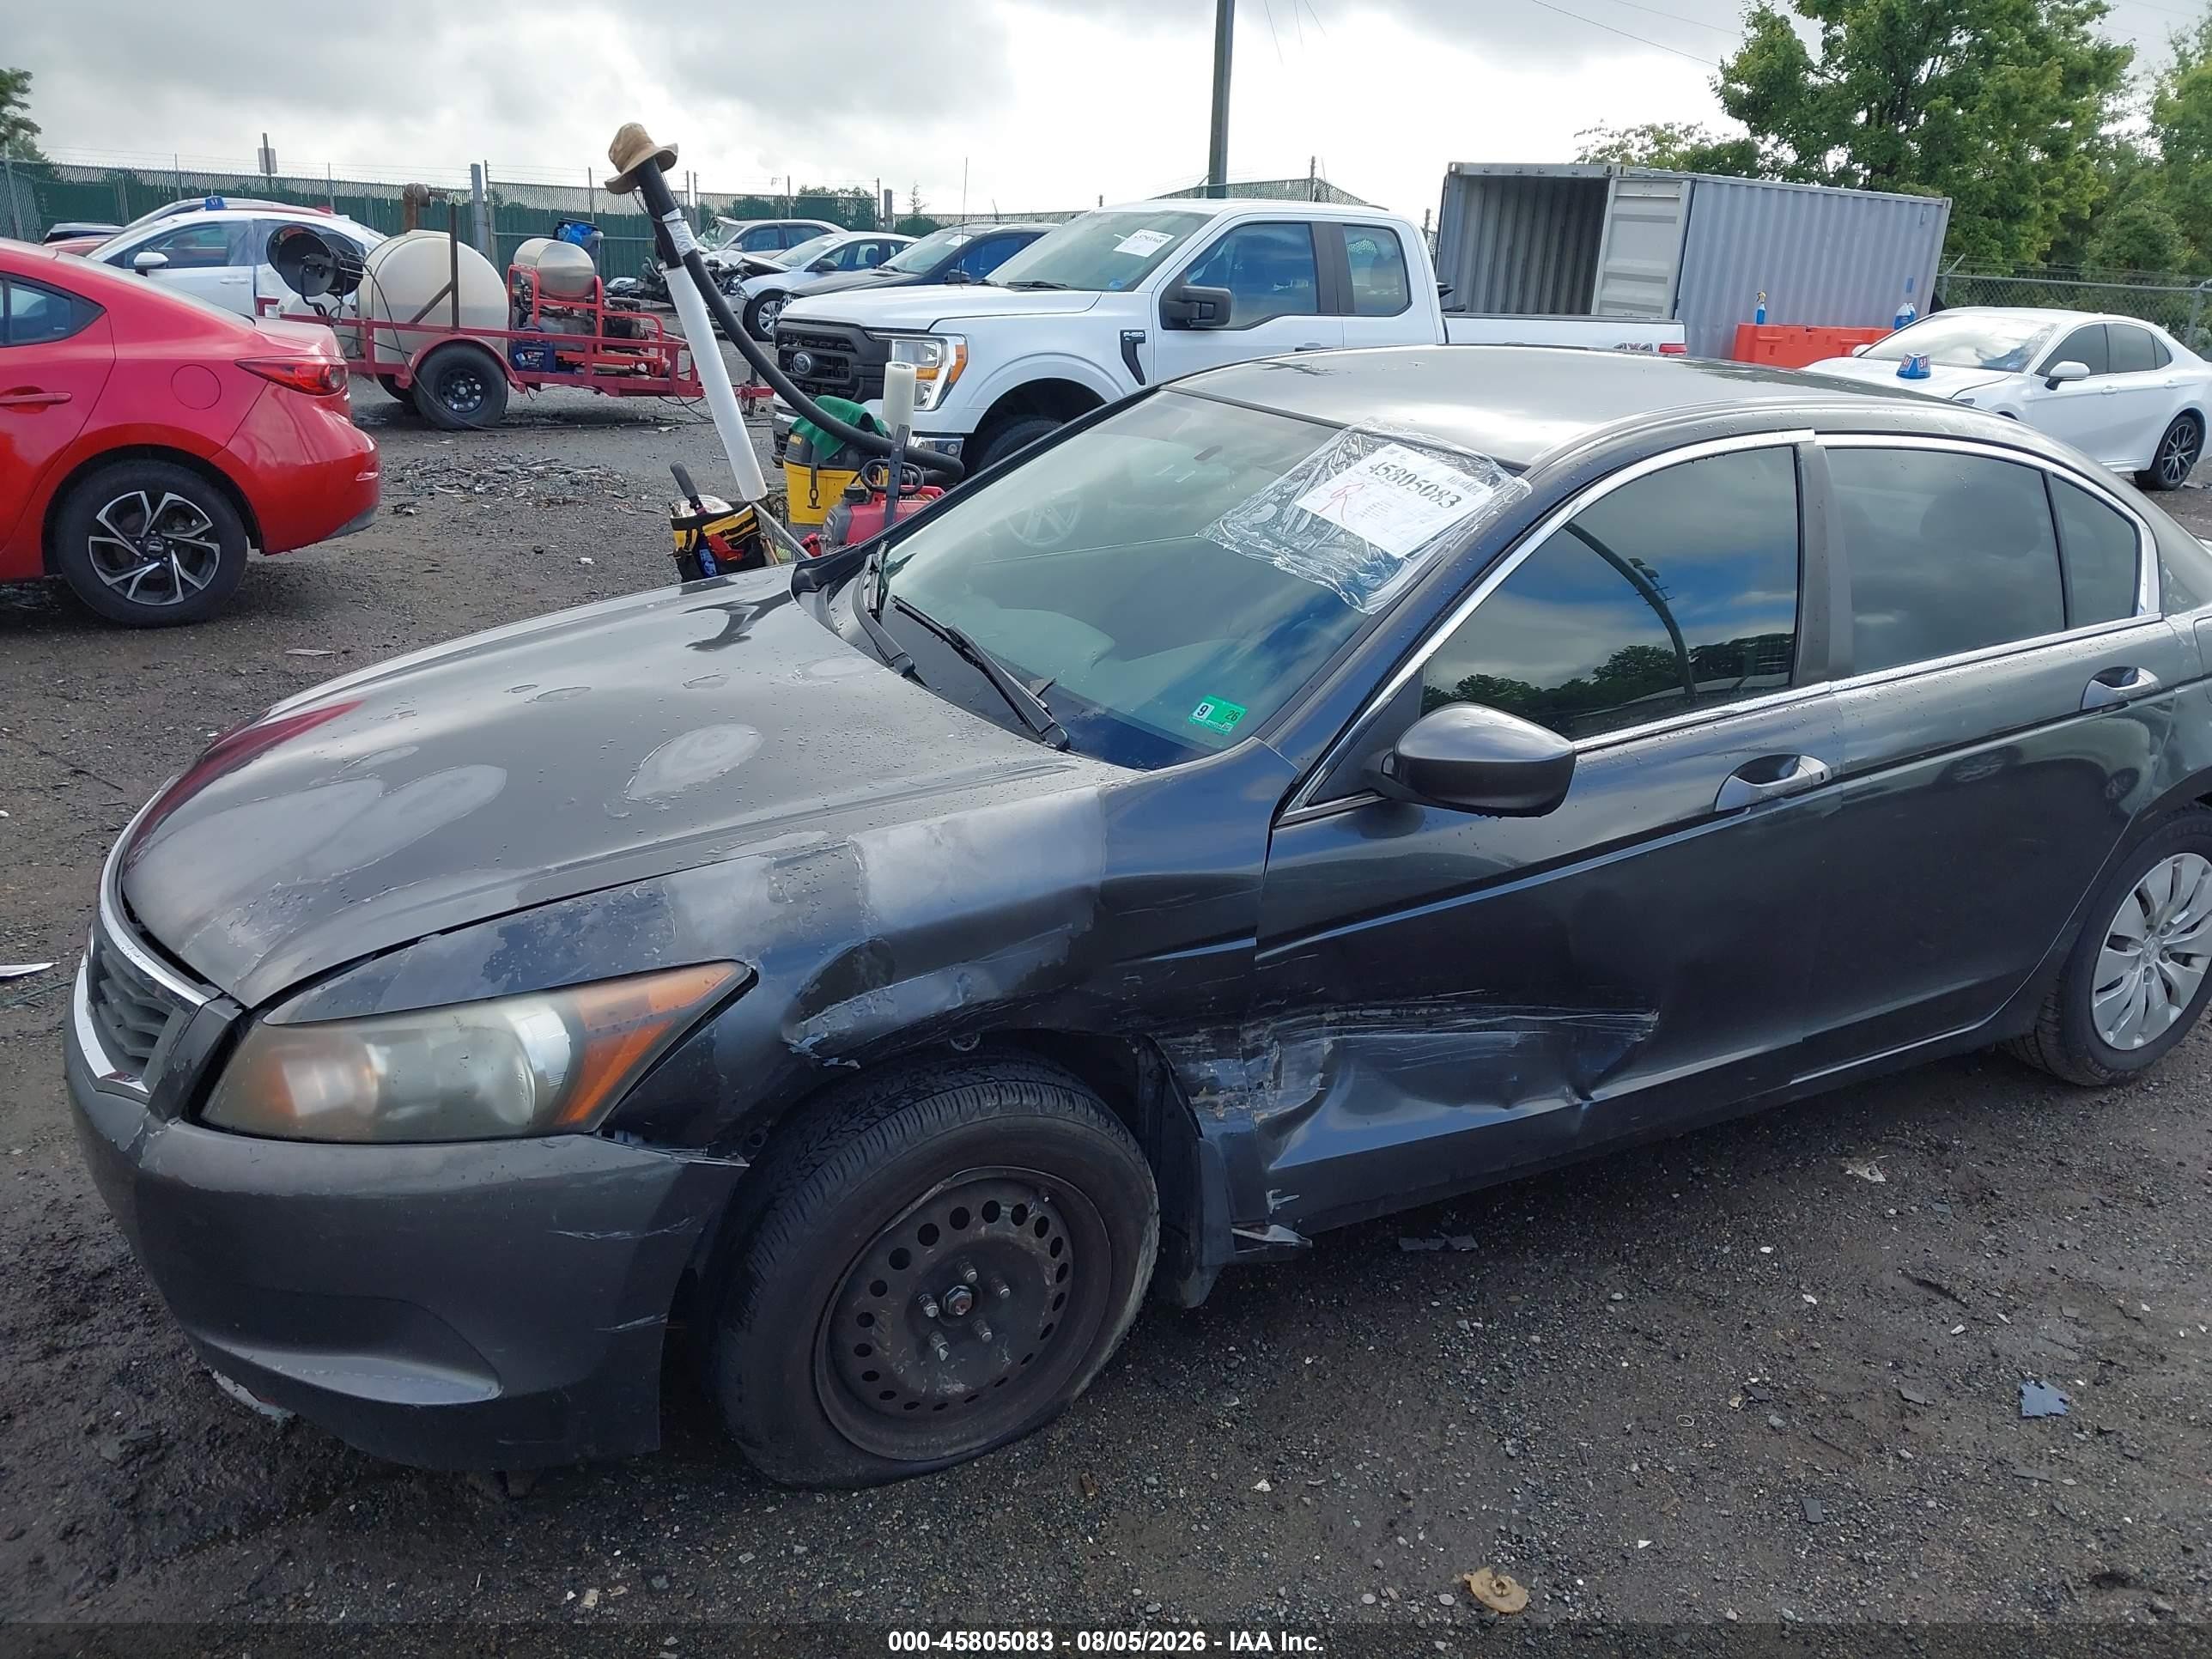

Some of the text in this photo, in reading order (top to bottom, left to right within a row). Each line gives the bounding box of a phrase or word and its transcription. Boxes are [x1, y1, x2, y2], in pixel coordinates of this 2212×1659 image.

[1368, 461, 1462, 509] 45805083
[1197, 704, 1209, 717] 9
[1224, 709, 1241, 722] 26
